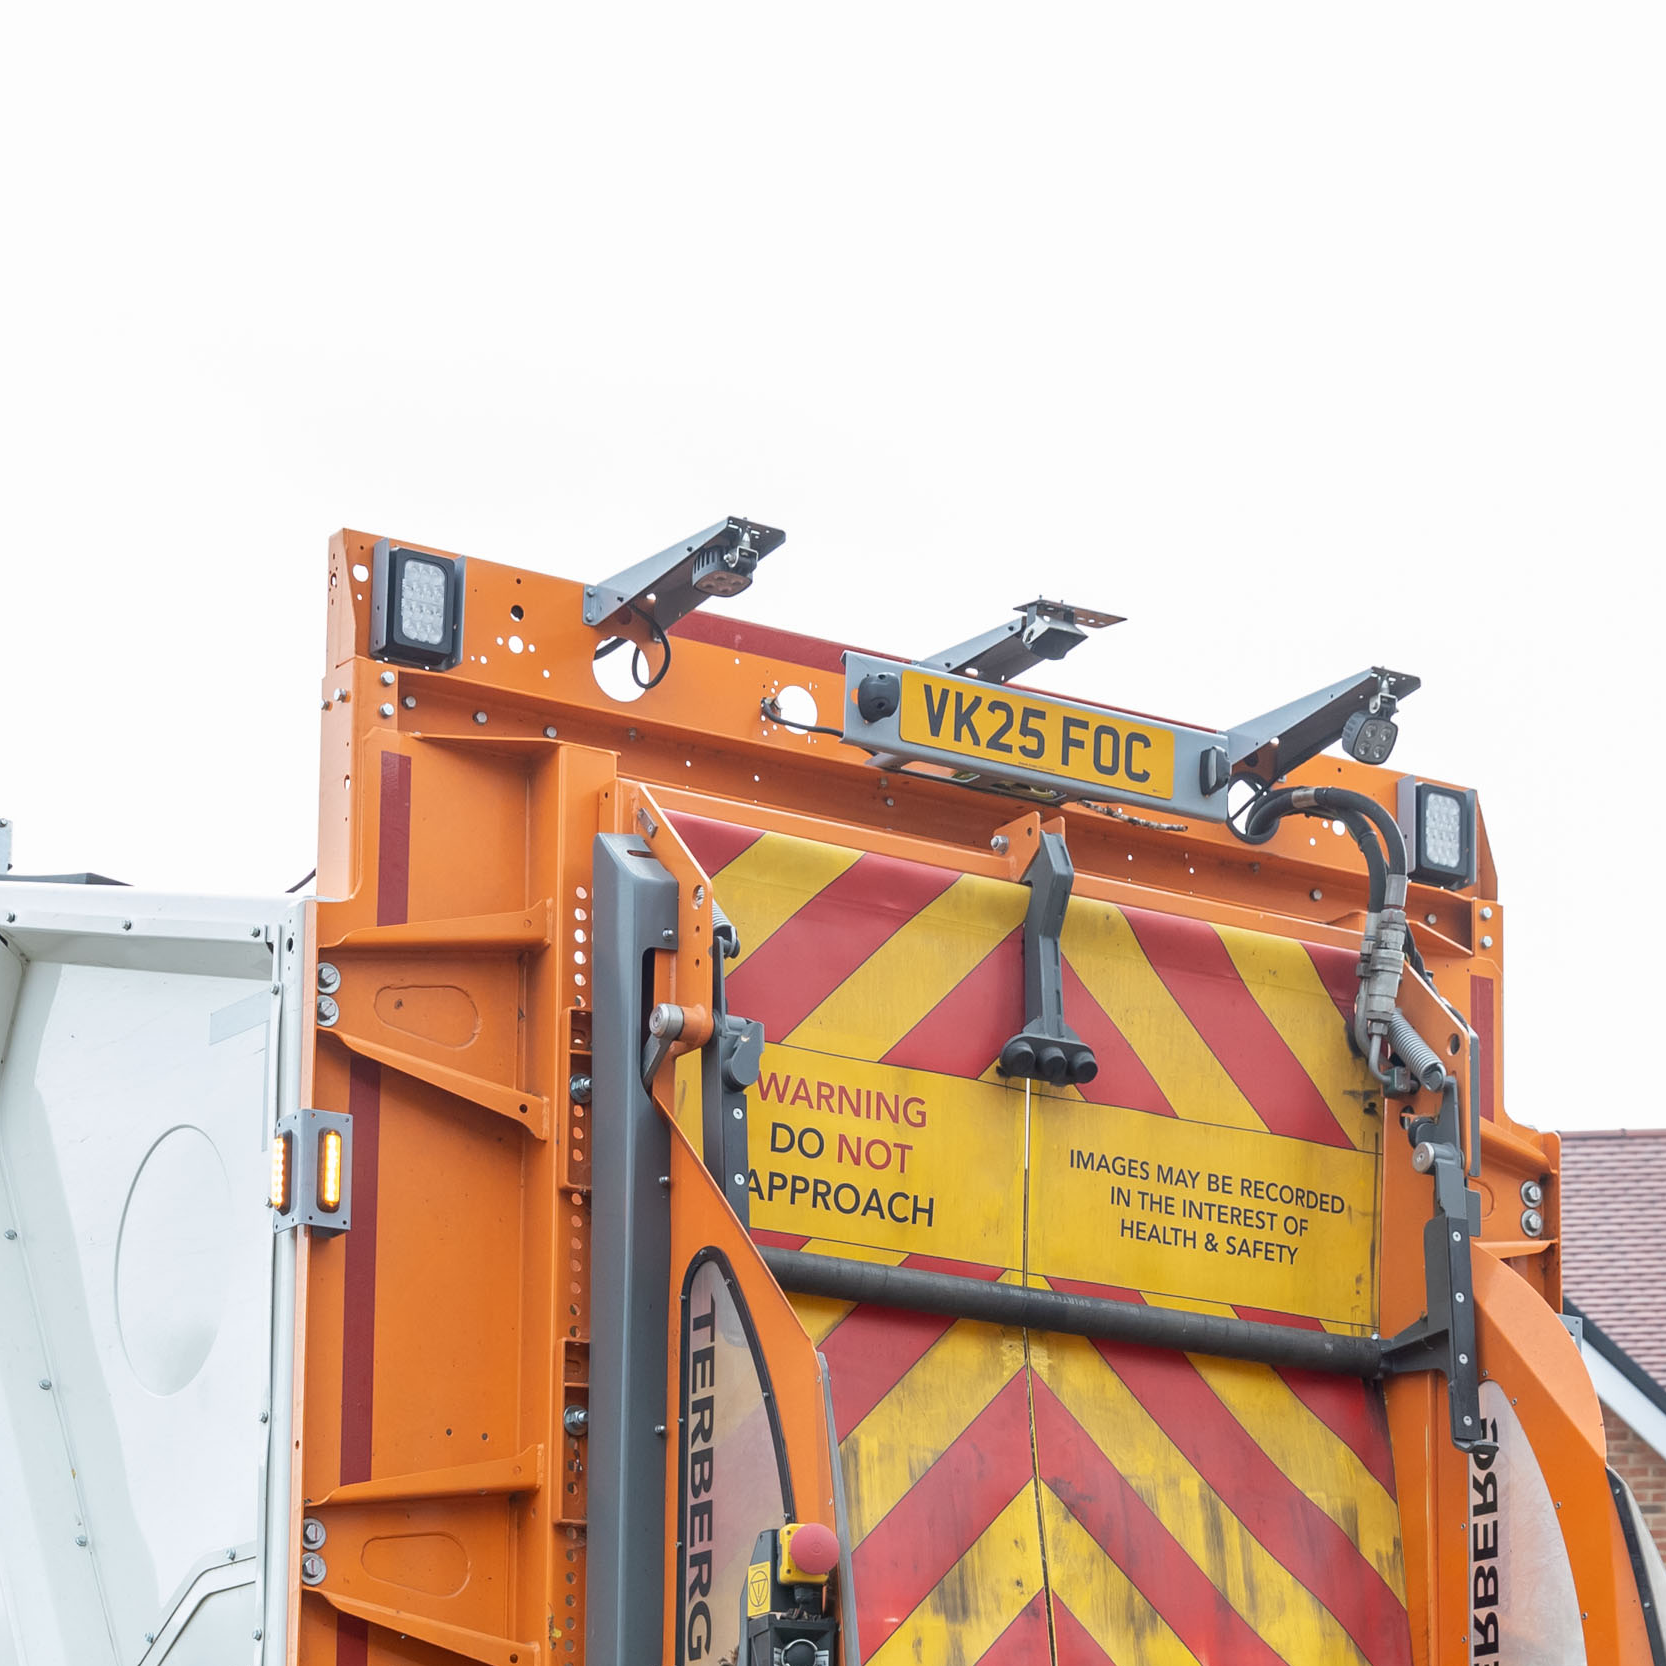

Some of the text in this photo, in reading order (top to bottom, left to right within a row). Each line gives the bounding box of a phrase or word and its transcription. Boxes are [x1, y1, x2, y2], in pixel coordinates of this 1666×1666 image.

[923, 683, 1152, 783] VK25 FOC
[757, 1070, 927, 1128] WARNING
[770, 1121, 913, 1174] DO NOT
[748, 1168, 934, 1227] APPROACH
[1069, 1149, 1345, 1214] IMAGES MAY BE RECORDED
[1110, 1186, 1309, 1237] IN THE INTEREST OF
[1120, 1218, 1298, 1265] HEALTH & SAFETY
[686, 1292, 716, 1663] TERBERG
